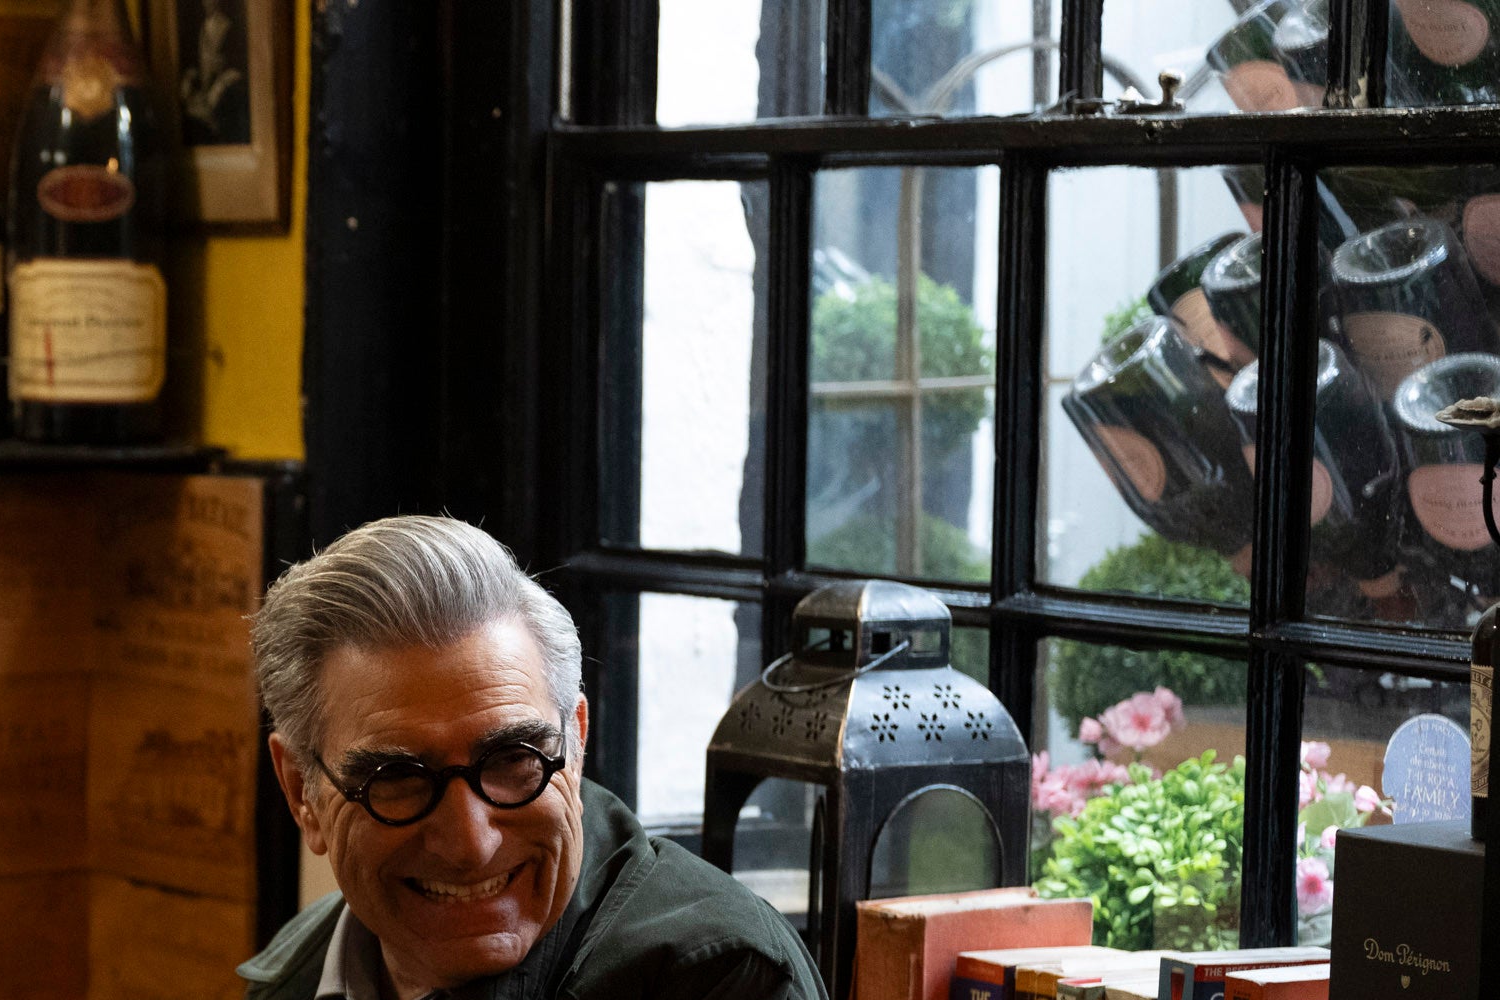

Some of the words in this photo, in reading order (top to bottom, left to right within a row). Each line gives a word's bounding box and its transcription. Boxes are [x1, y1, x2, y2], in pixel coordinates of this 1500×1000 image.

[1403, 783, 1461, 809] FAMILY
[1363, 937, 1395, 963] Dom
[1396, 943, 1451, 976] Pérignon
